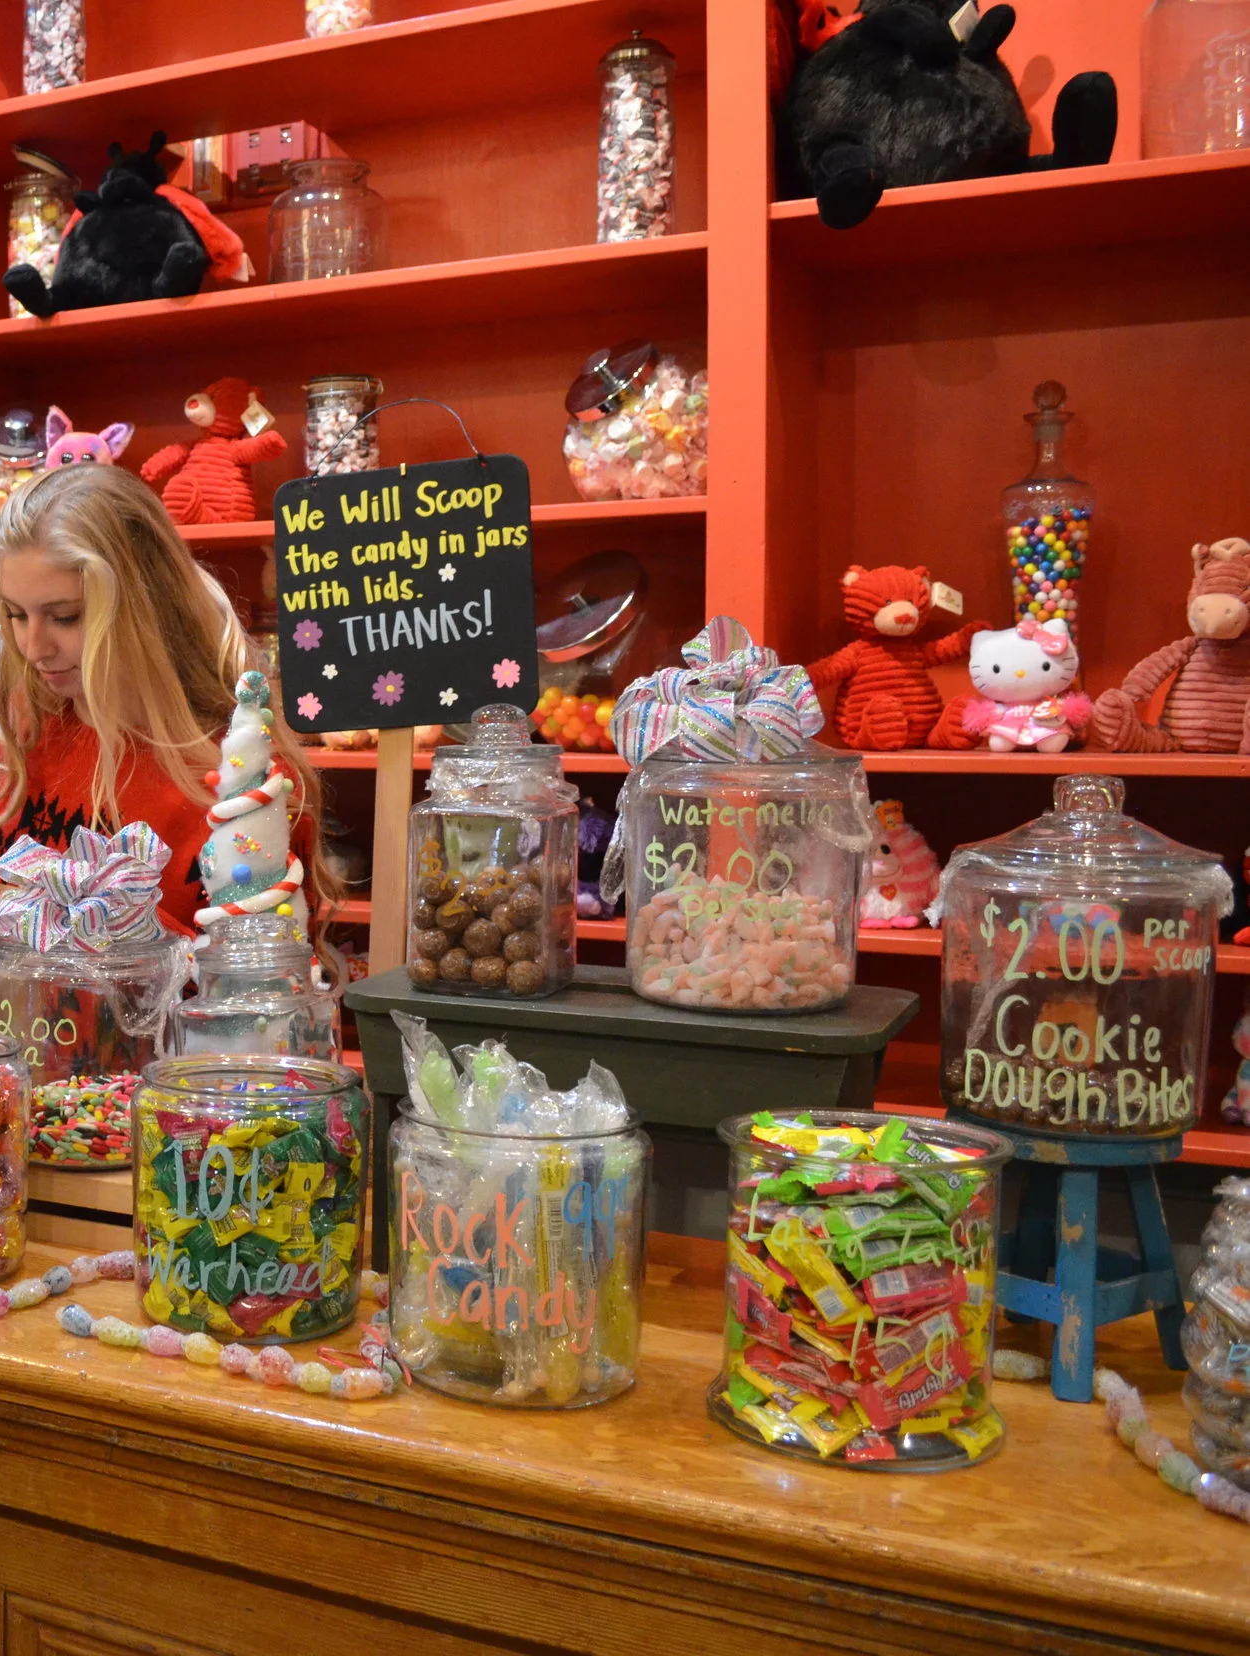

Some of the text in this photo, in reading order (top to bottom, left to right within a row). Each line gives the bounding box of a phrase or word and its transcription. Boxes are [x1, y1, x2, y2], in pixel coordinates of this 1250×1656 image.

[281, 480, 503, 535] We Will Scoop
[285, 525, 529, 576] the candy in jars
[283, 570, 424, 612] with lids.
[338, 588, 493, 656] THANKS!
[1144, 918, 1190, 948] per
[996, 994, 1161, 1063] Cookie
[402, 1170, 533, 1268] Rock
[428, 1257, 597, 1354] Candy
